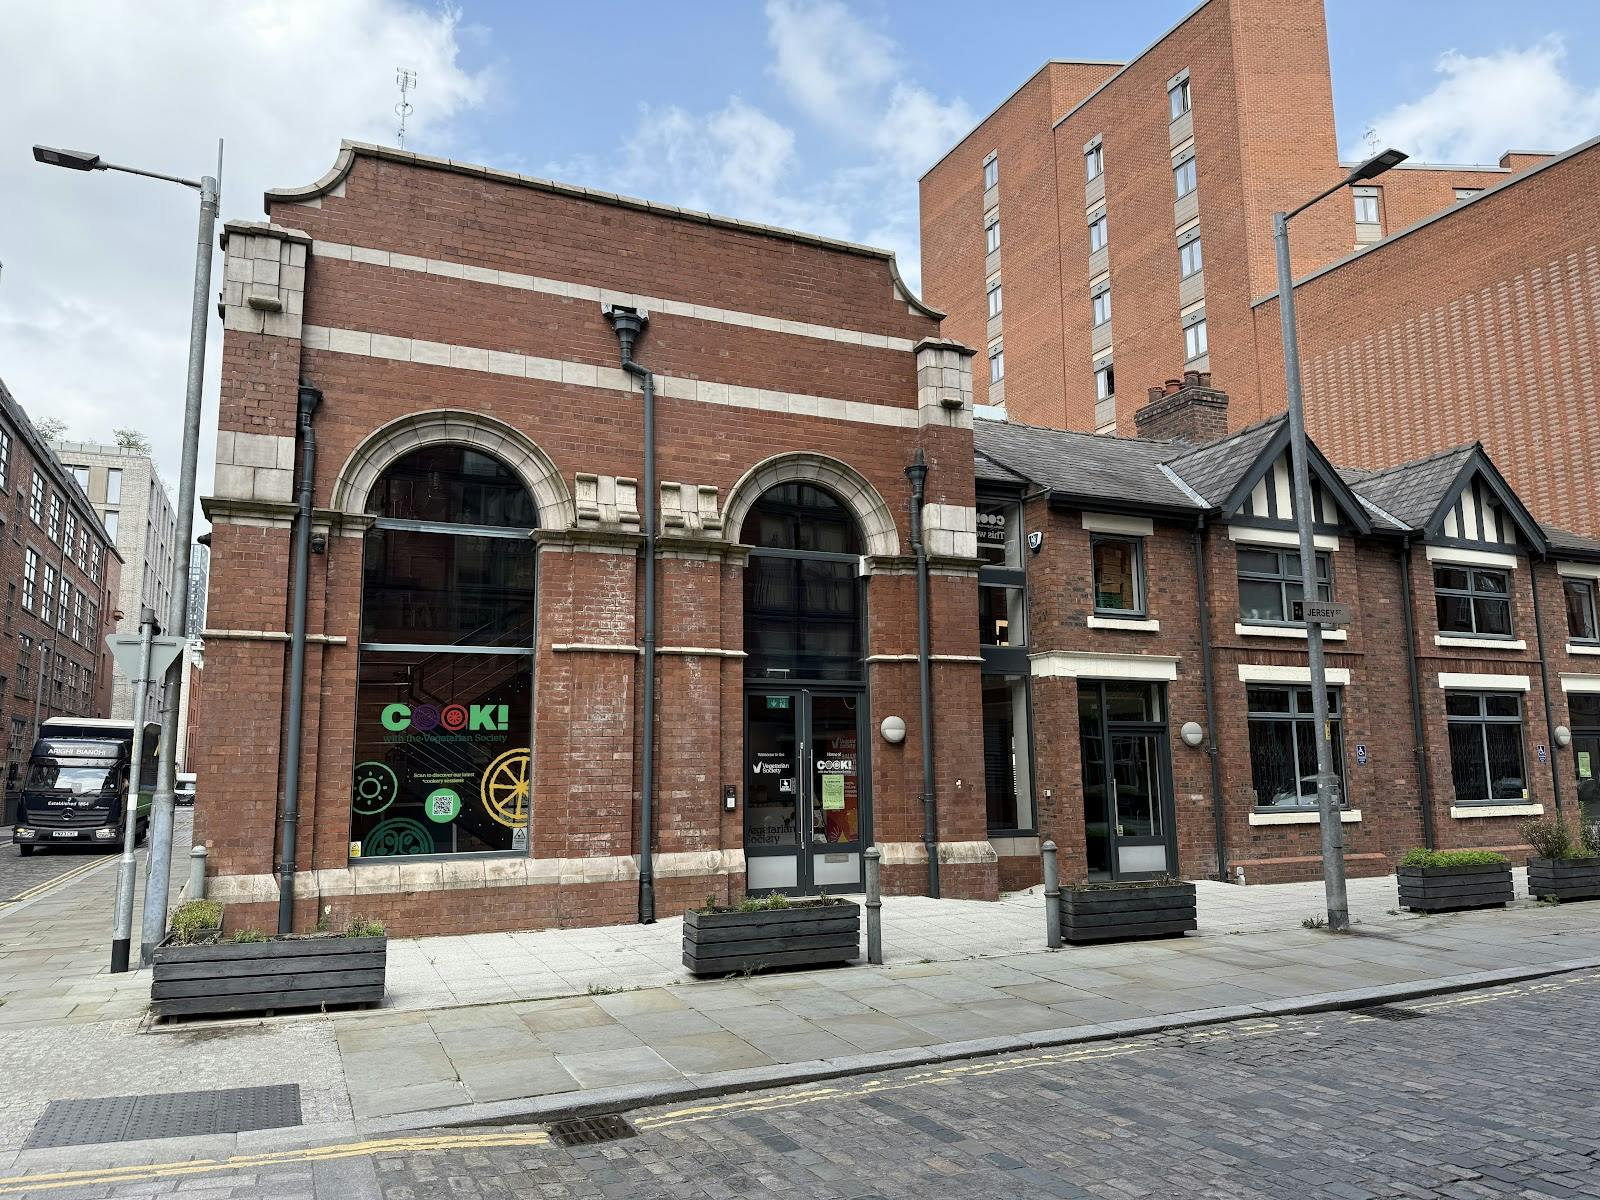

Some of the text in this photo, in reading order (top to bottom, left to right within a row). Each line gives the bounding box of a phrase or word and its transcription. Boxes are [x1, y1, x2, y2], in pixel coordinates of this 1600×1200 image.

[1308, 609, 1335, 617] JERSEY
[381, 704, 509, 731] COOK!
[424, 734, 473, 743] Vegetarian
[474, 734, 508, 743] Society
[816, 760, 852, 770] COOK!
